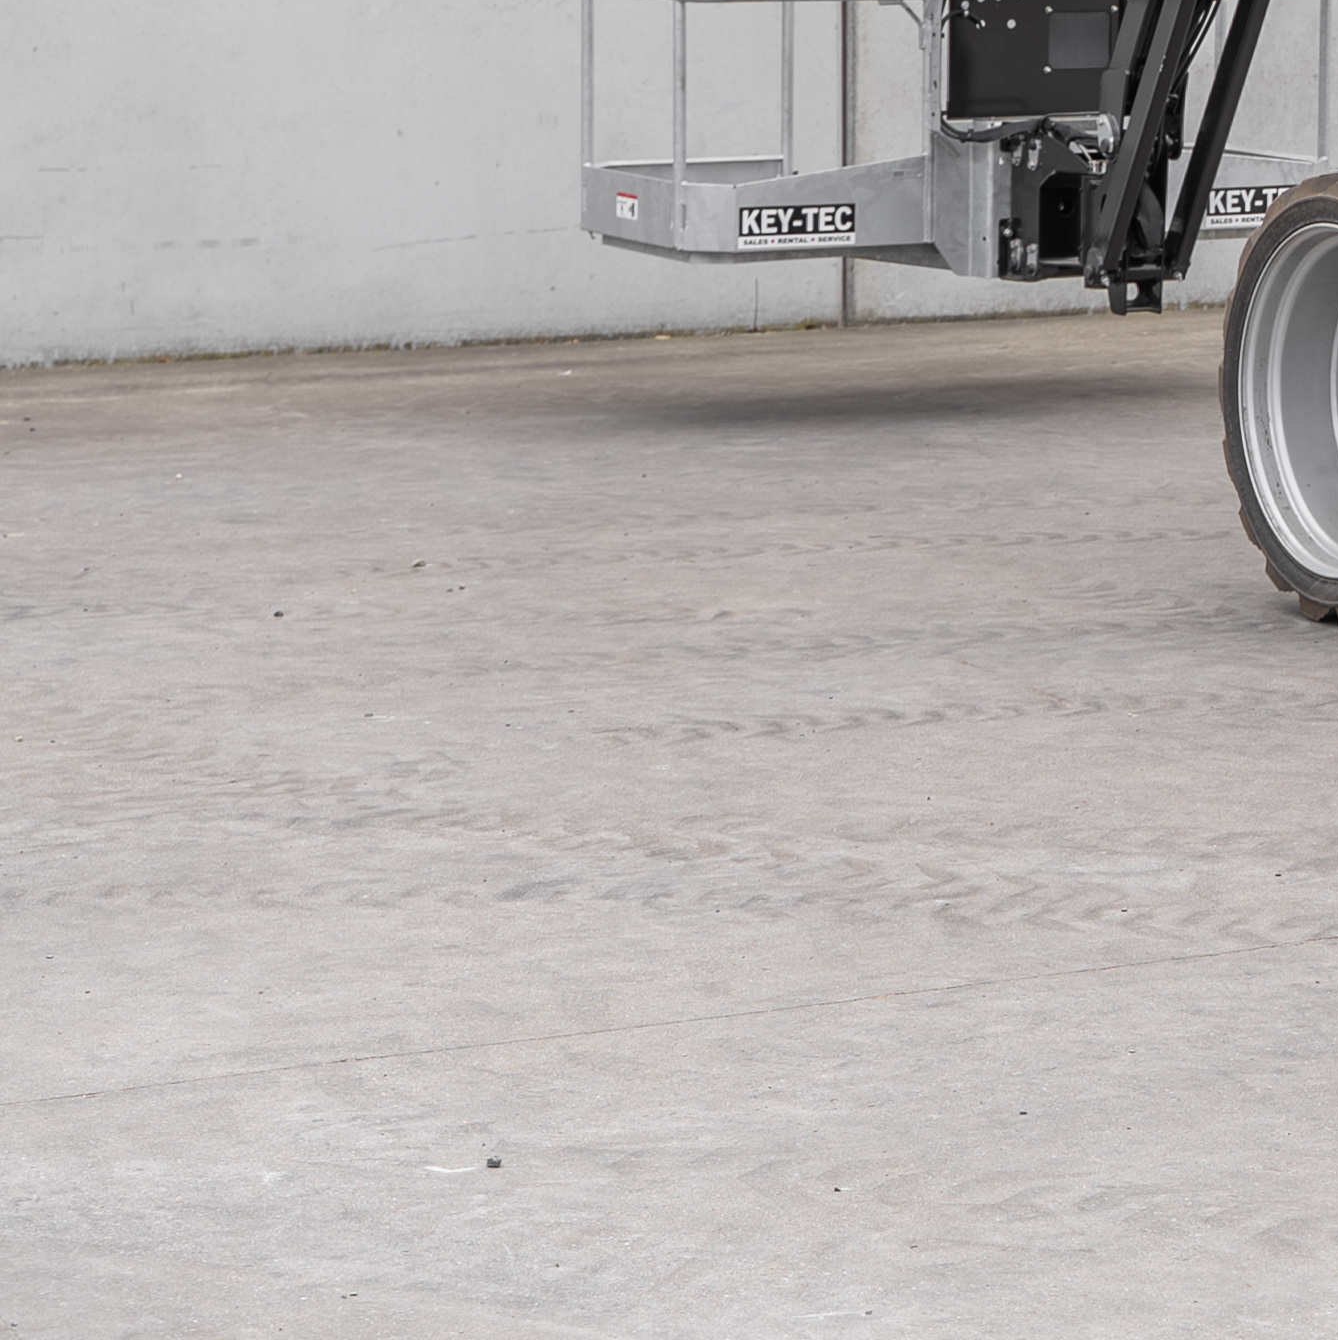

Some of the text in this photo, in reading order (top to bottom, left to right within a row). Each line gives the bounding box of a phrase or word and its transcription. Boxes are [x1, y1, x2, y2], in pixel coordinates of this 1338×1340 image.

[1209, 188, 1290, 214] KEY-T
[741, 206, 853, 235] KEY-TEC
[817, 235, 851, 243] SERVICE
